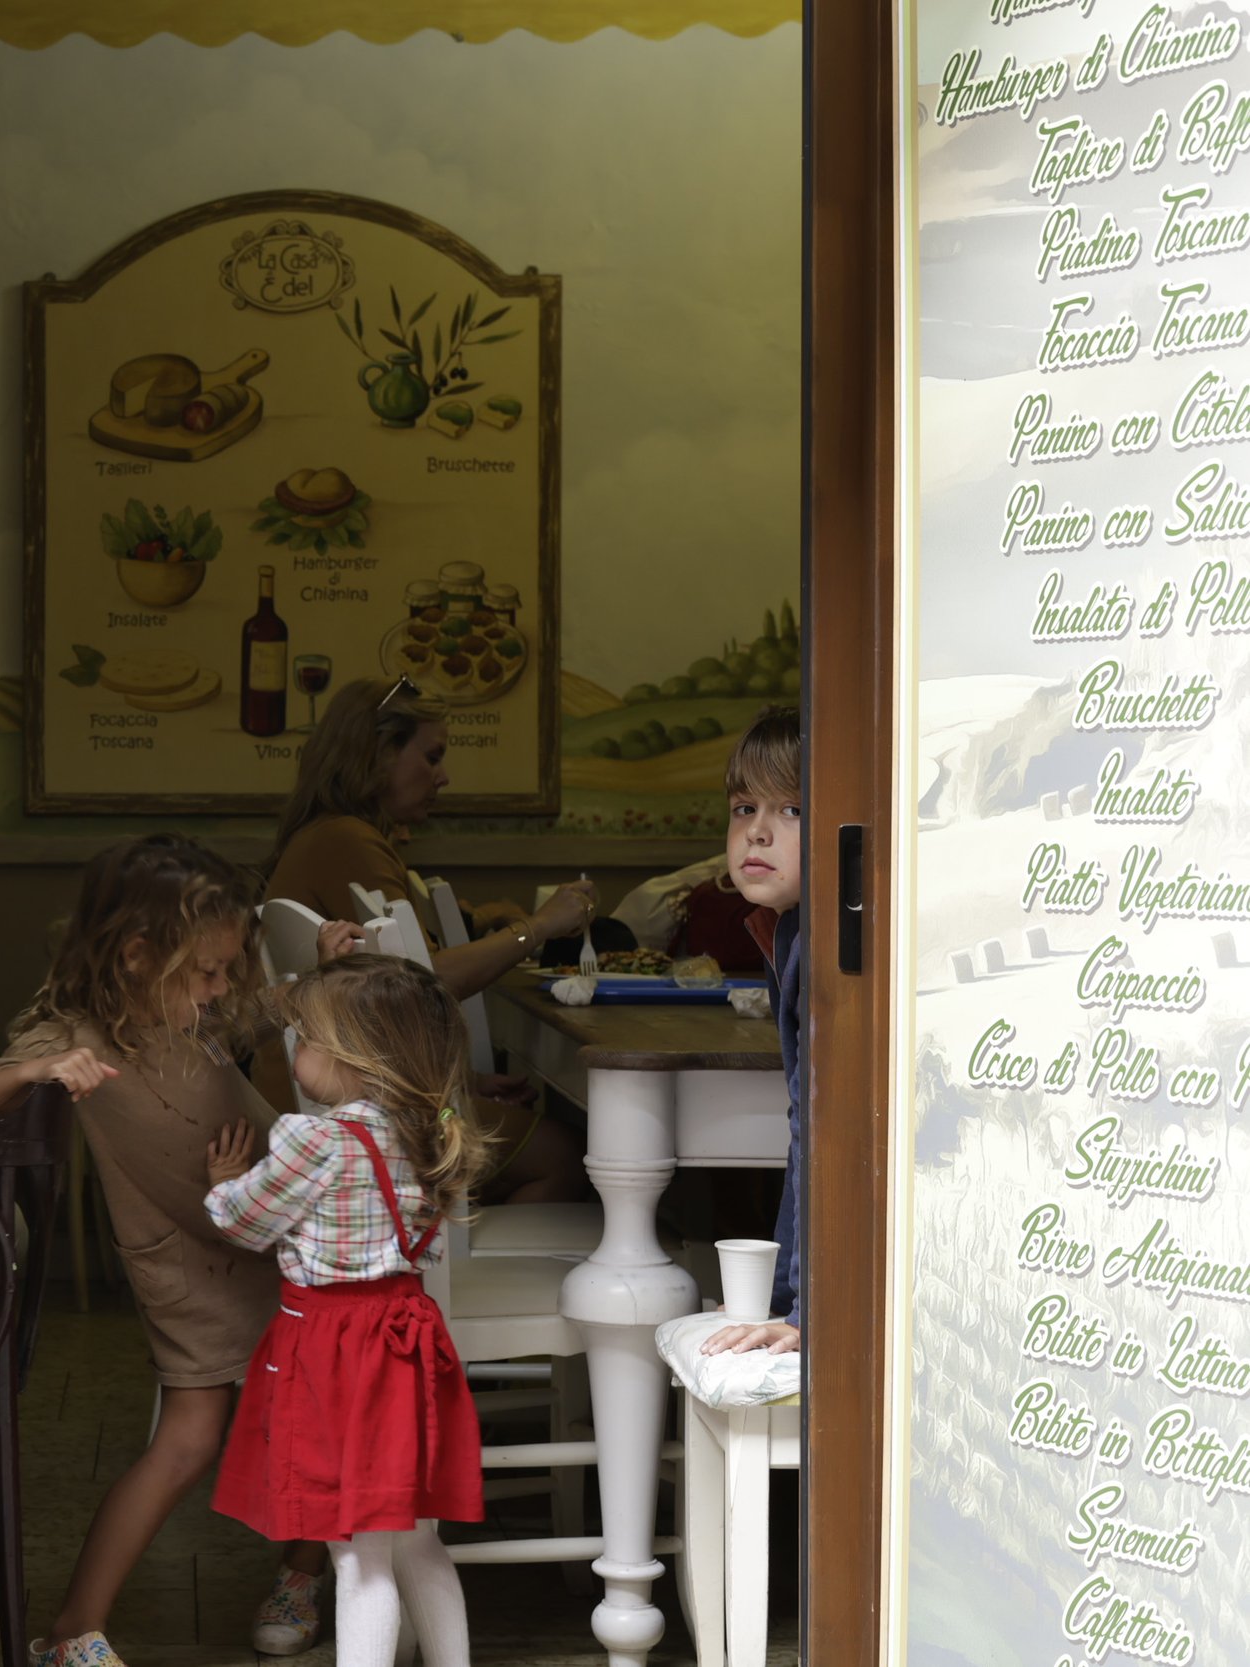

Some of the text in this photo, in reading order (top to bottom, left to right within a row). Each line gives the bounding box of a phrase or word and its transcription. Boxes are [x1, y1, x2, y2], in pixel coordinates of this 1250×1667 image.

[936, 5, 1237, 120] Hamburger di Chianina
[1031, 118, 1123, 195] Tagliere
[1133, 113, 1167, 166] di
[280, 242, 319, 275] Casa
[1036, 187, 1250, 276] Piadina Toscana
[1039, 282, 1249, 366] Focaccia Toscana
[1008, 392, 1100, 461] Panino
[1111, 414, 1157, 450] con
[94, 460, 153, 477] Taglieri
[426, 456, 516, 474] Bruschette
[1001, 484, 1091, 550] Panino
[1103, 508, 1149, 541] con
[293, 556, 380, 573] Hamburger
[300, 586, 369, 603] Chianina
[107, 611, 168, 628] Insalate
[1032, 571, 1131, 637] Insalata
[1139, 580, 1172, 631] di
[89, 712, 159, 729] Focaccia
[446, 710, 502, 726] rostini
[1075, 659, 1216, 726] Bruschette
[88, 734, 154, 750] Toscana
[254, 743, 292, 761] Vino
[448, 732, 499, 749] oscani
[1094, 752, 1197, 817] Insalate
[1021, 842, 1250, 925] Piatto Vegetarian
[1076, 935, 1201, 1016] Carpaccio
[1043, 1041, 1075, 1087] di
[1086, 1027, 1156, 1095] Pollo
[1170, 1067, 1219, 1099] con
[1064, 1116, 1216, 1201] Stuzzichini
[1017, 1202, 1091, 1271] Birre
[1023, 1294, 1250, 1390] Bibite in Lattina
[1010, 1382, 1095, 1451] Bibite
[1099, 1422, 1129, 1461] in
[1068, 1484, 1200, 1567] Spremute
[1063, 1576, 1192, 1661] Caffetteria
